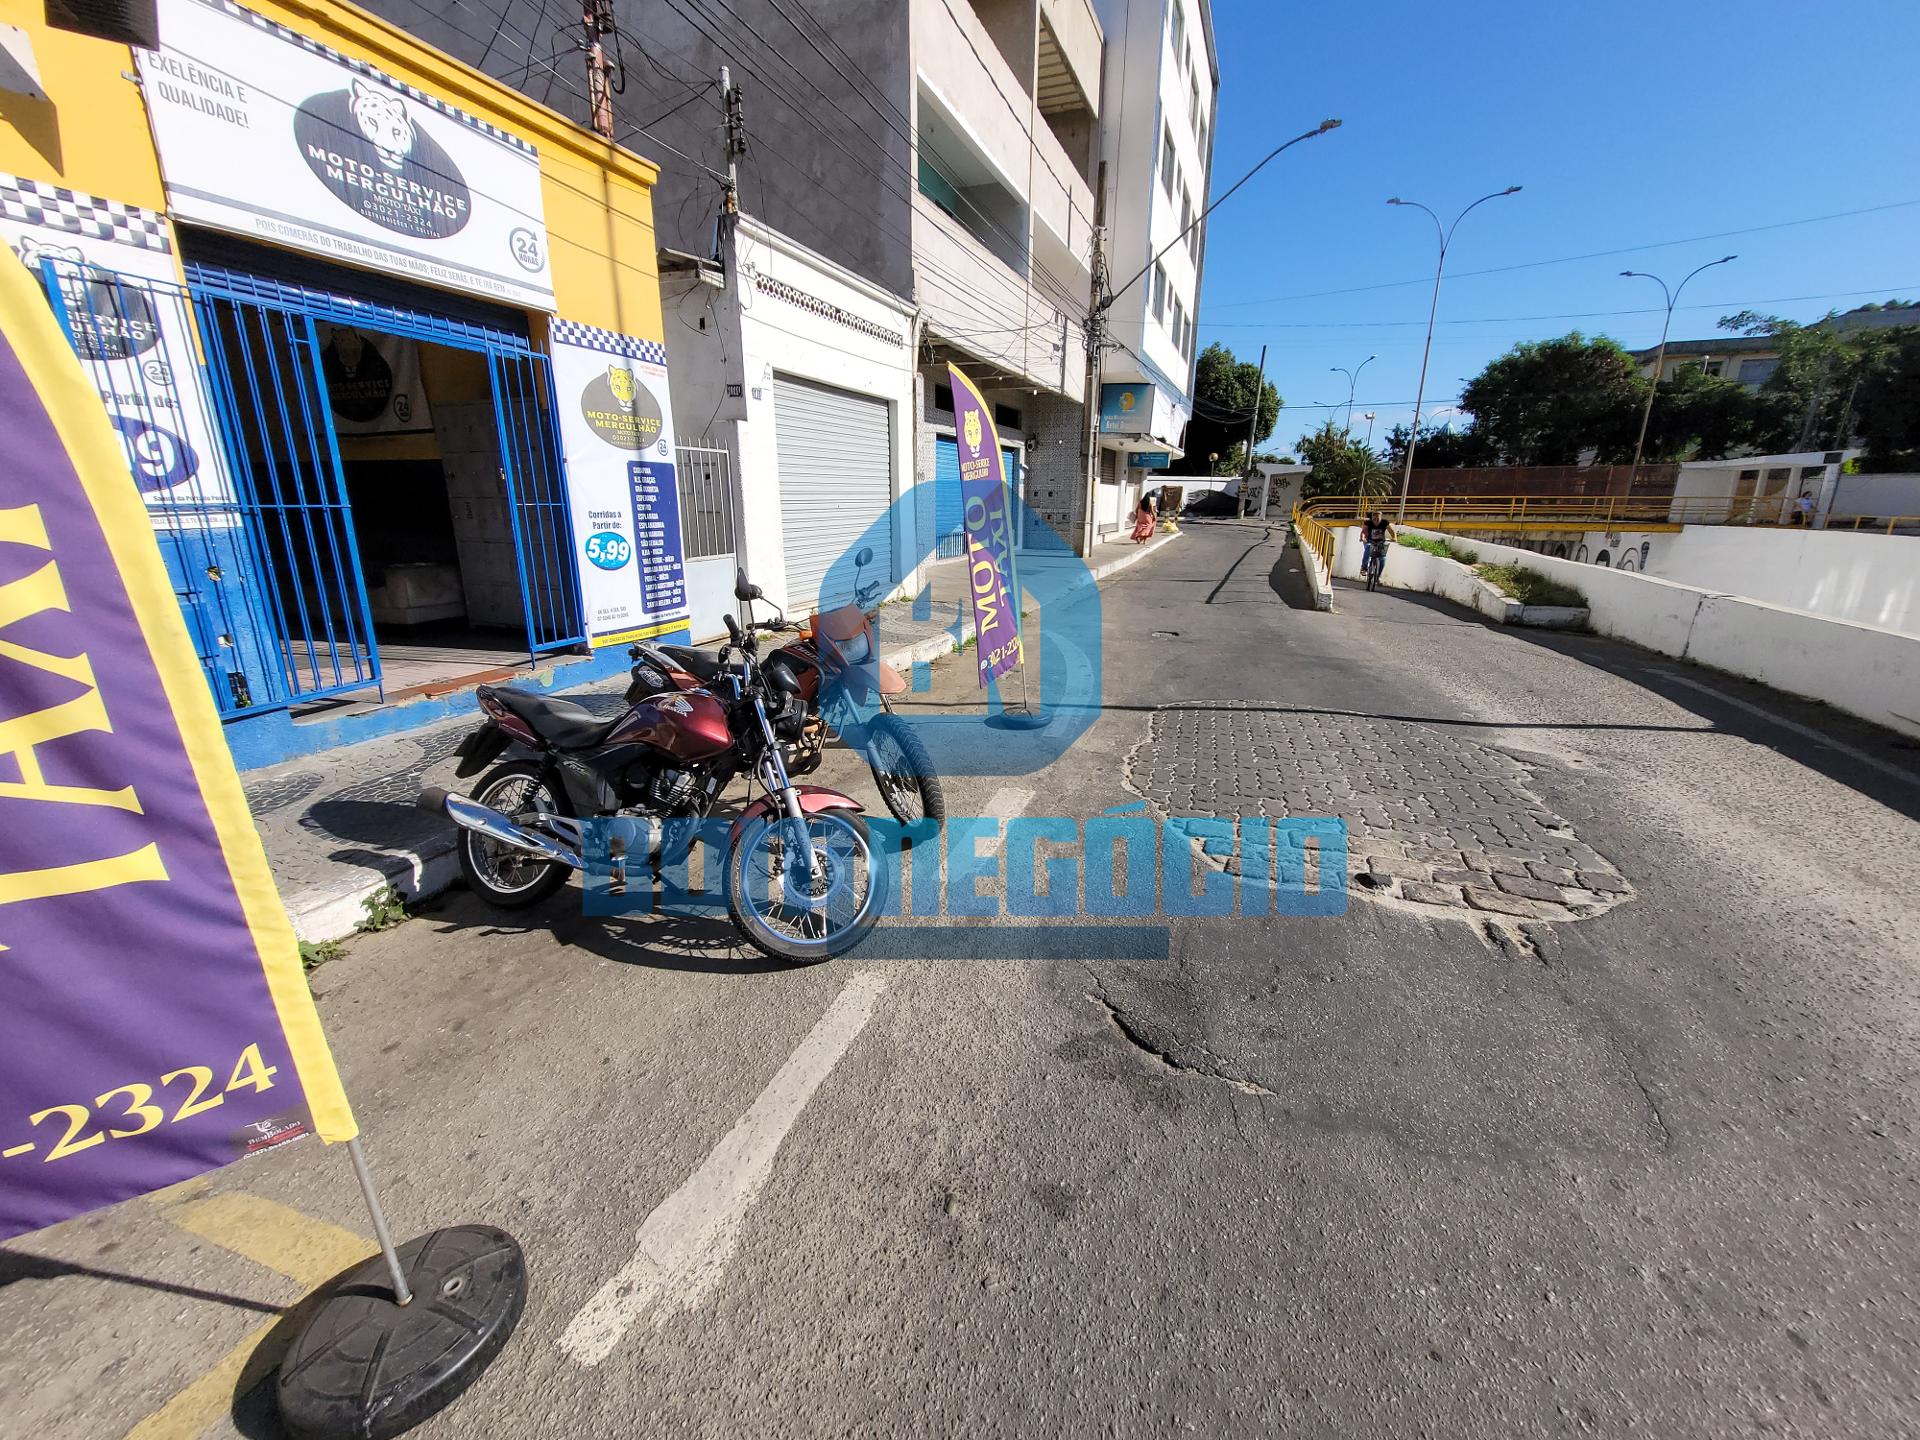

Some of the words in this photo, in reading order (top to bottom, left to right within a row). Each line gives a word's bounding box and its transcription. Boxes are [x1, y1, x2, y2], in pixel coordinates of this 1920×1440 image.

[148, 50, 234, 99] EXELÊNCIA
[237, 85, 248, 104] E
[158, 80, 250, 129] QUALIDADE!
[307, 143, 467, 211] MOTO-SERVICE
[326, 164, 457, 219] MERGULHÃO
[373, 193, 401, 210] MOTO
[333, 239, 373, 259] TRABALHO
[516, 237, 538, 257] 24
[588, 510, 617, 519] Corridas
[592, 521, 611, 529] Partir
[587, 537, 629, 563] 5,99
[966, 496, 998, 636] MOTO
